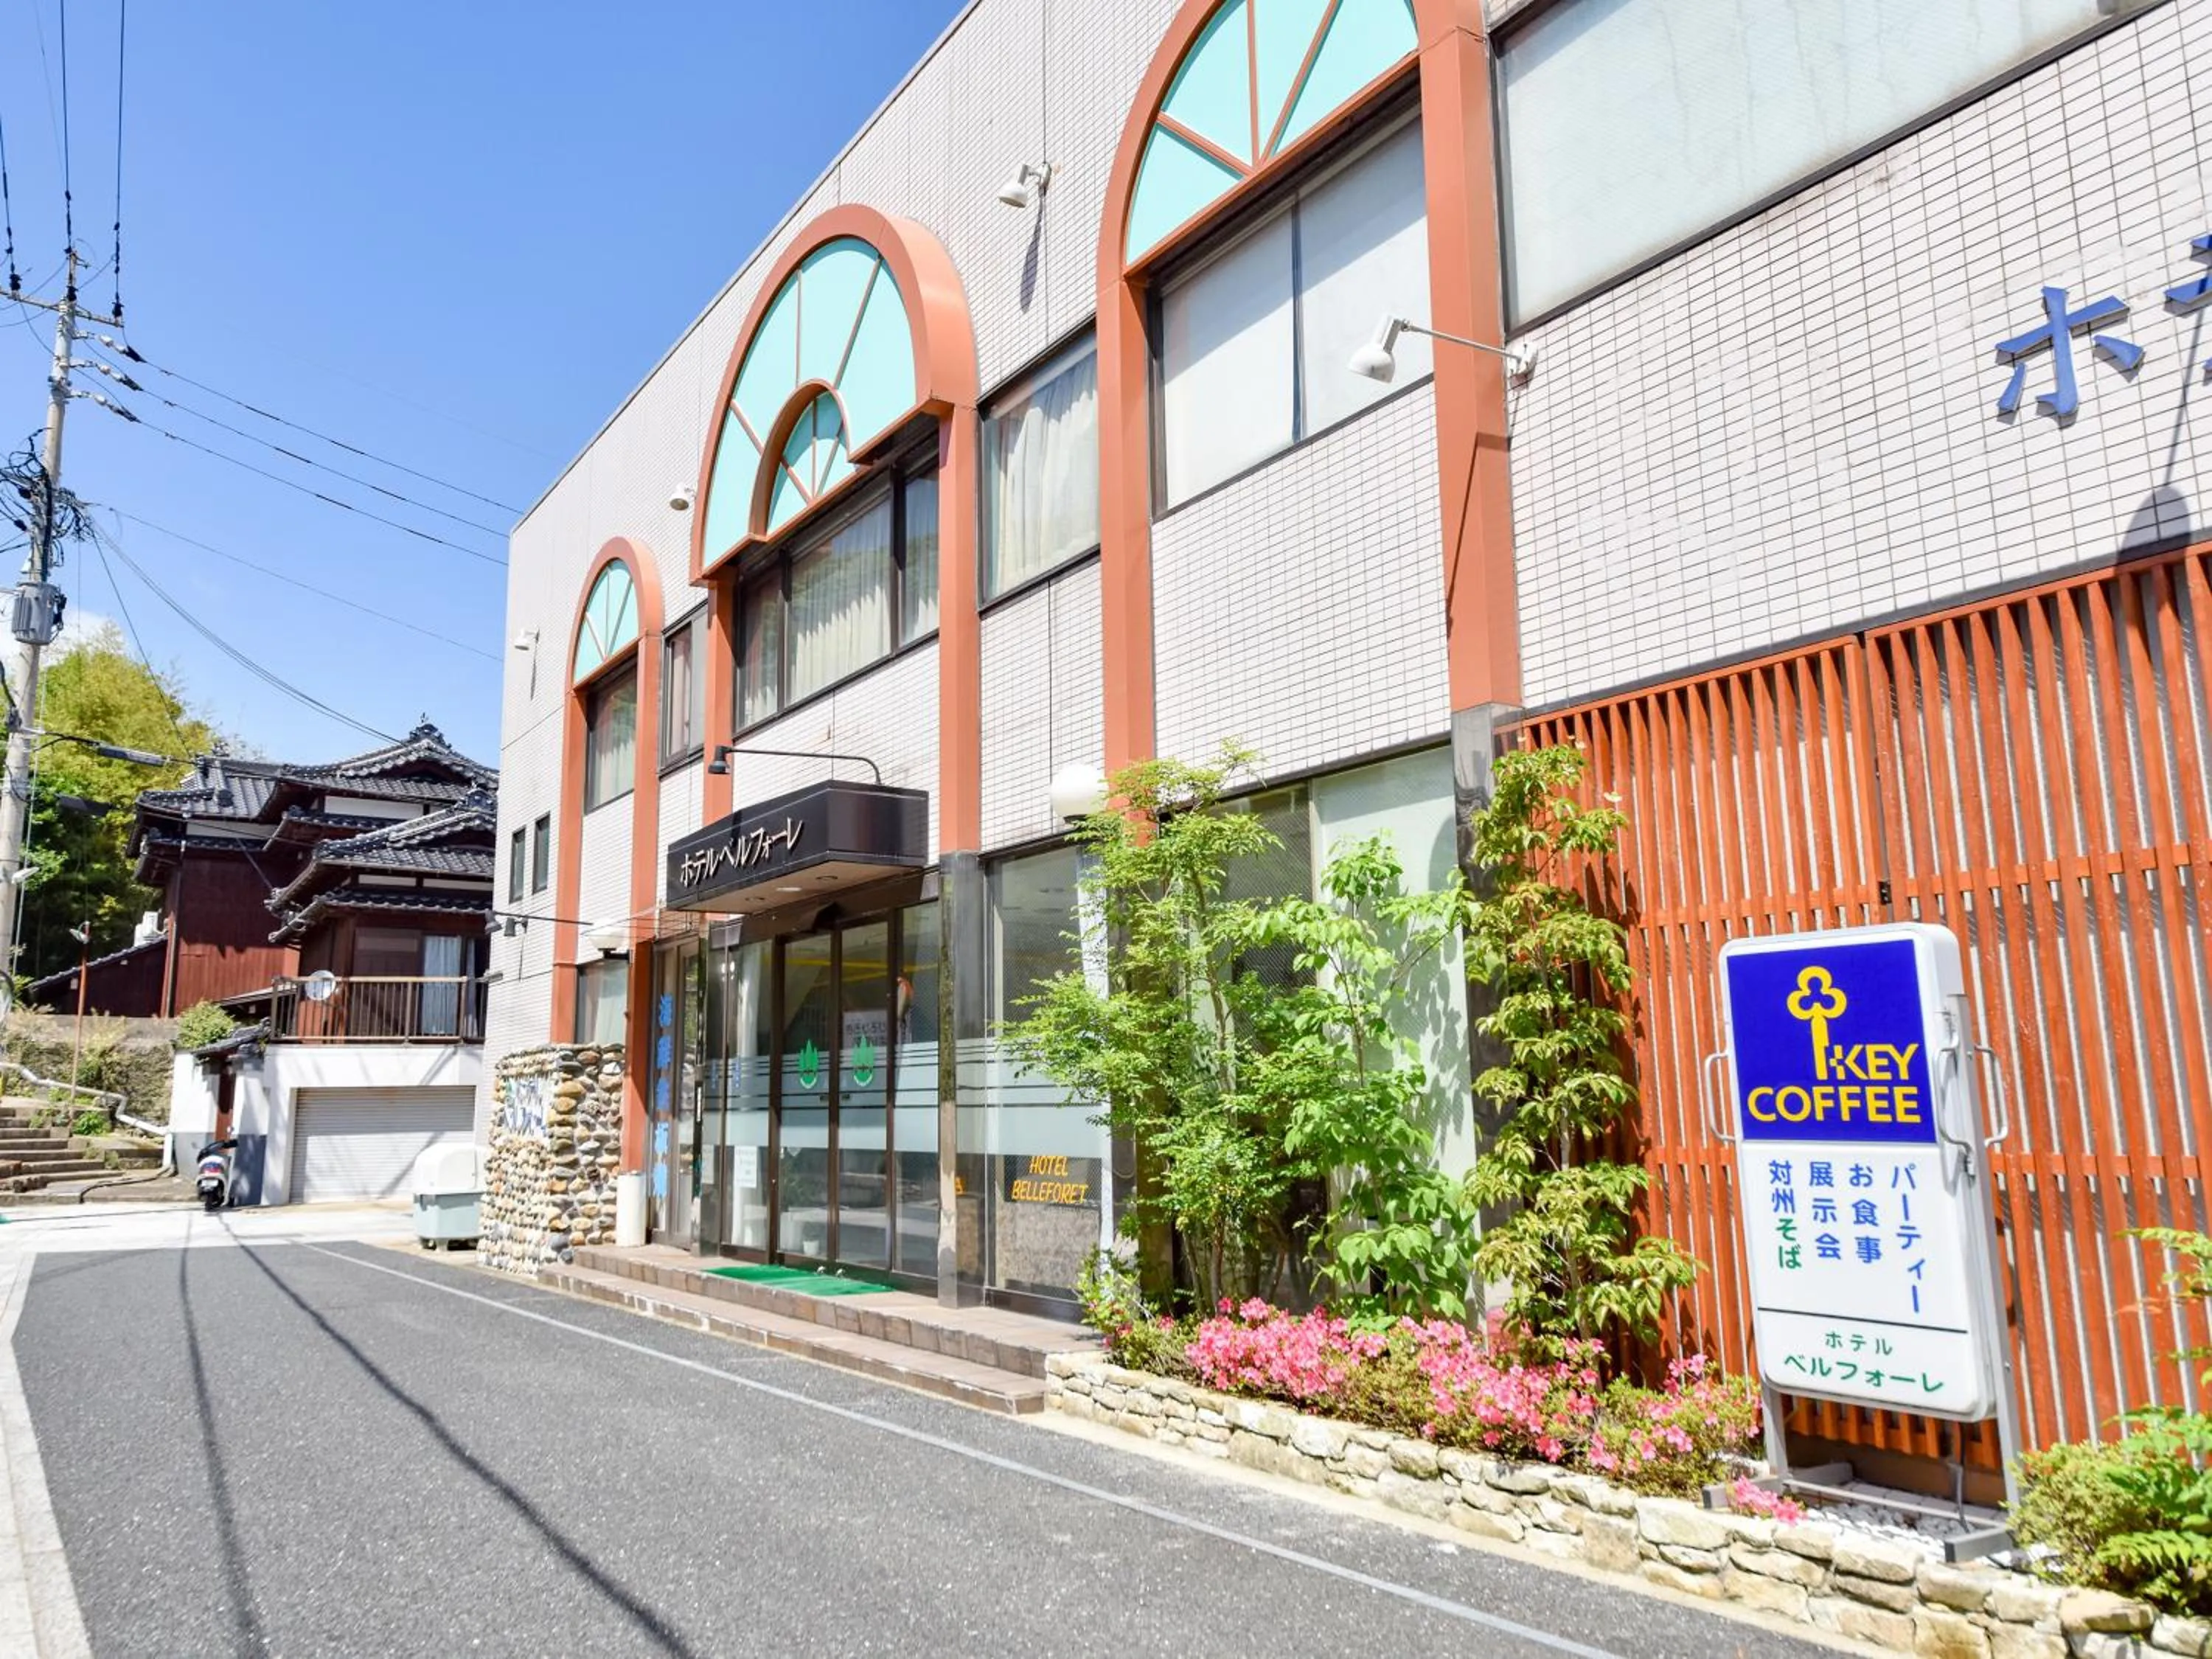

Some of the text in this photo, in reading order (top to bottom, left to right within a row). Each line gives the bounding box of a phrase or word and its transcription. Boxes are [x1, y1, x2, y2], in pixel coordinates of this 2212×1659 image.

[680, 816, 803, 888] ホテルベルフォーレ
[1829, 1043, 1919, 1080] KEY
[1747, 1085, 1921, 1123] COFFEE
[1029, 1155, 1069, 1177] HOTEL
[1011, 1179, 1089, 1204] BELLEFORET
[1809, 1161, 1842, 1260] 展示会
[1769, 1159, 1802, 1270] 対州そば
[1848, 1163, 1882, 1265] お食事
[1891, 1163, 1926, 1313] パーティー
[1825, 1331, 1893, 1356] ホテル
[1784, 1354, 1944, 1393] ベルフォーレ
